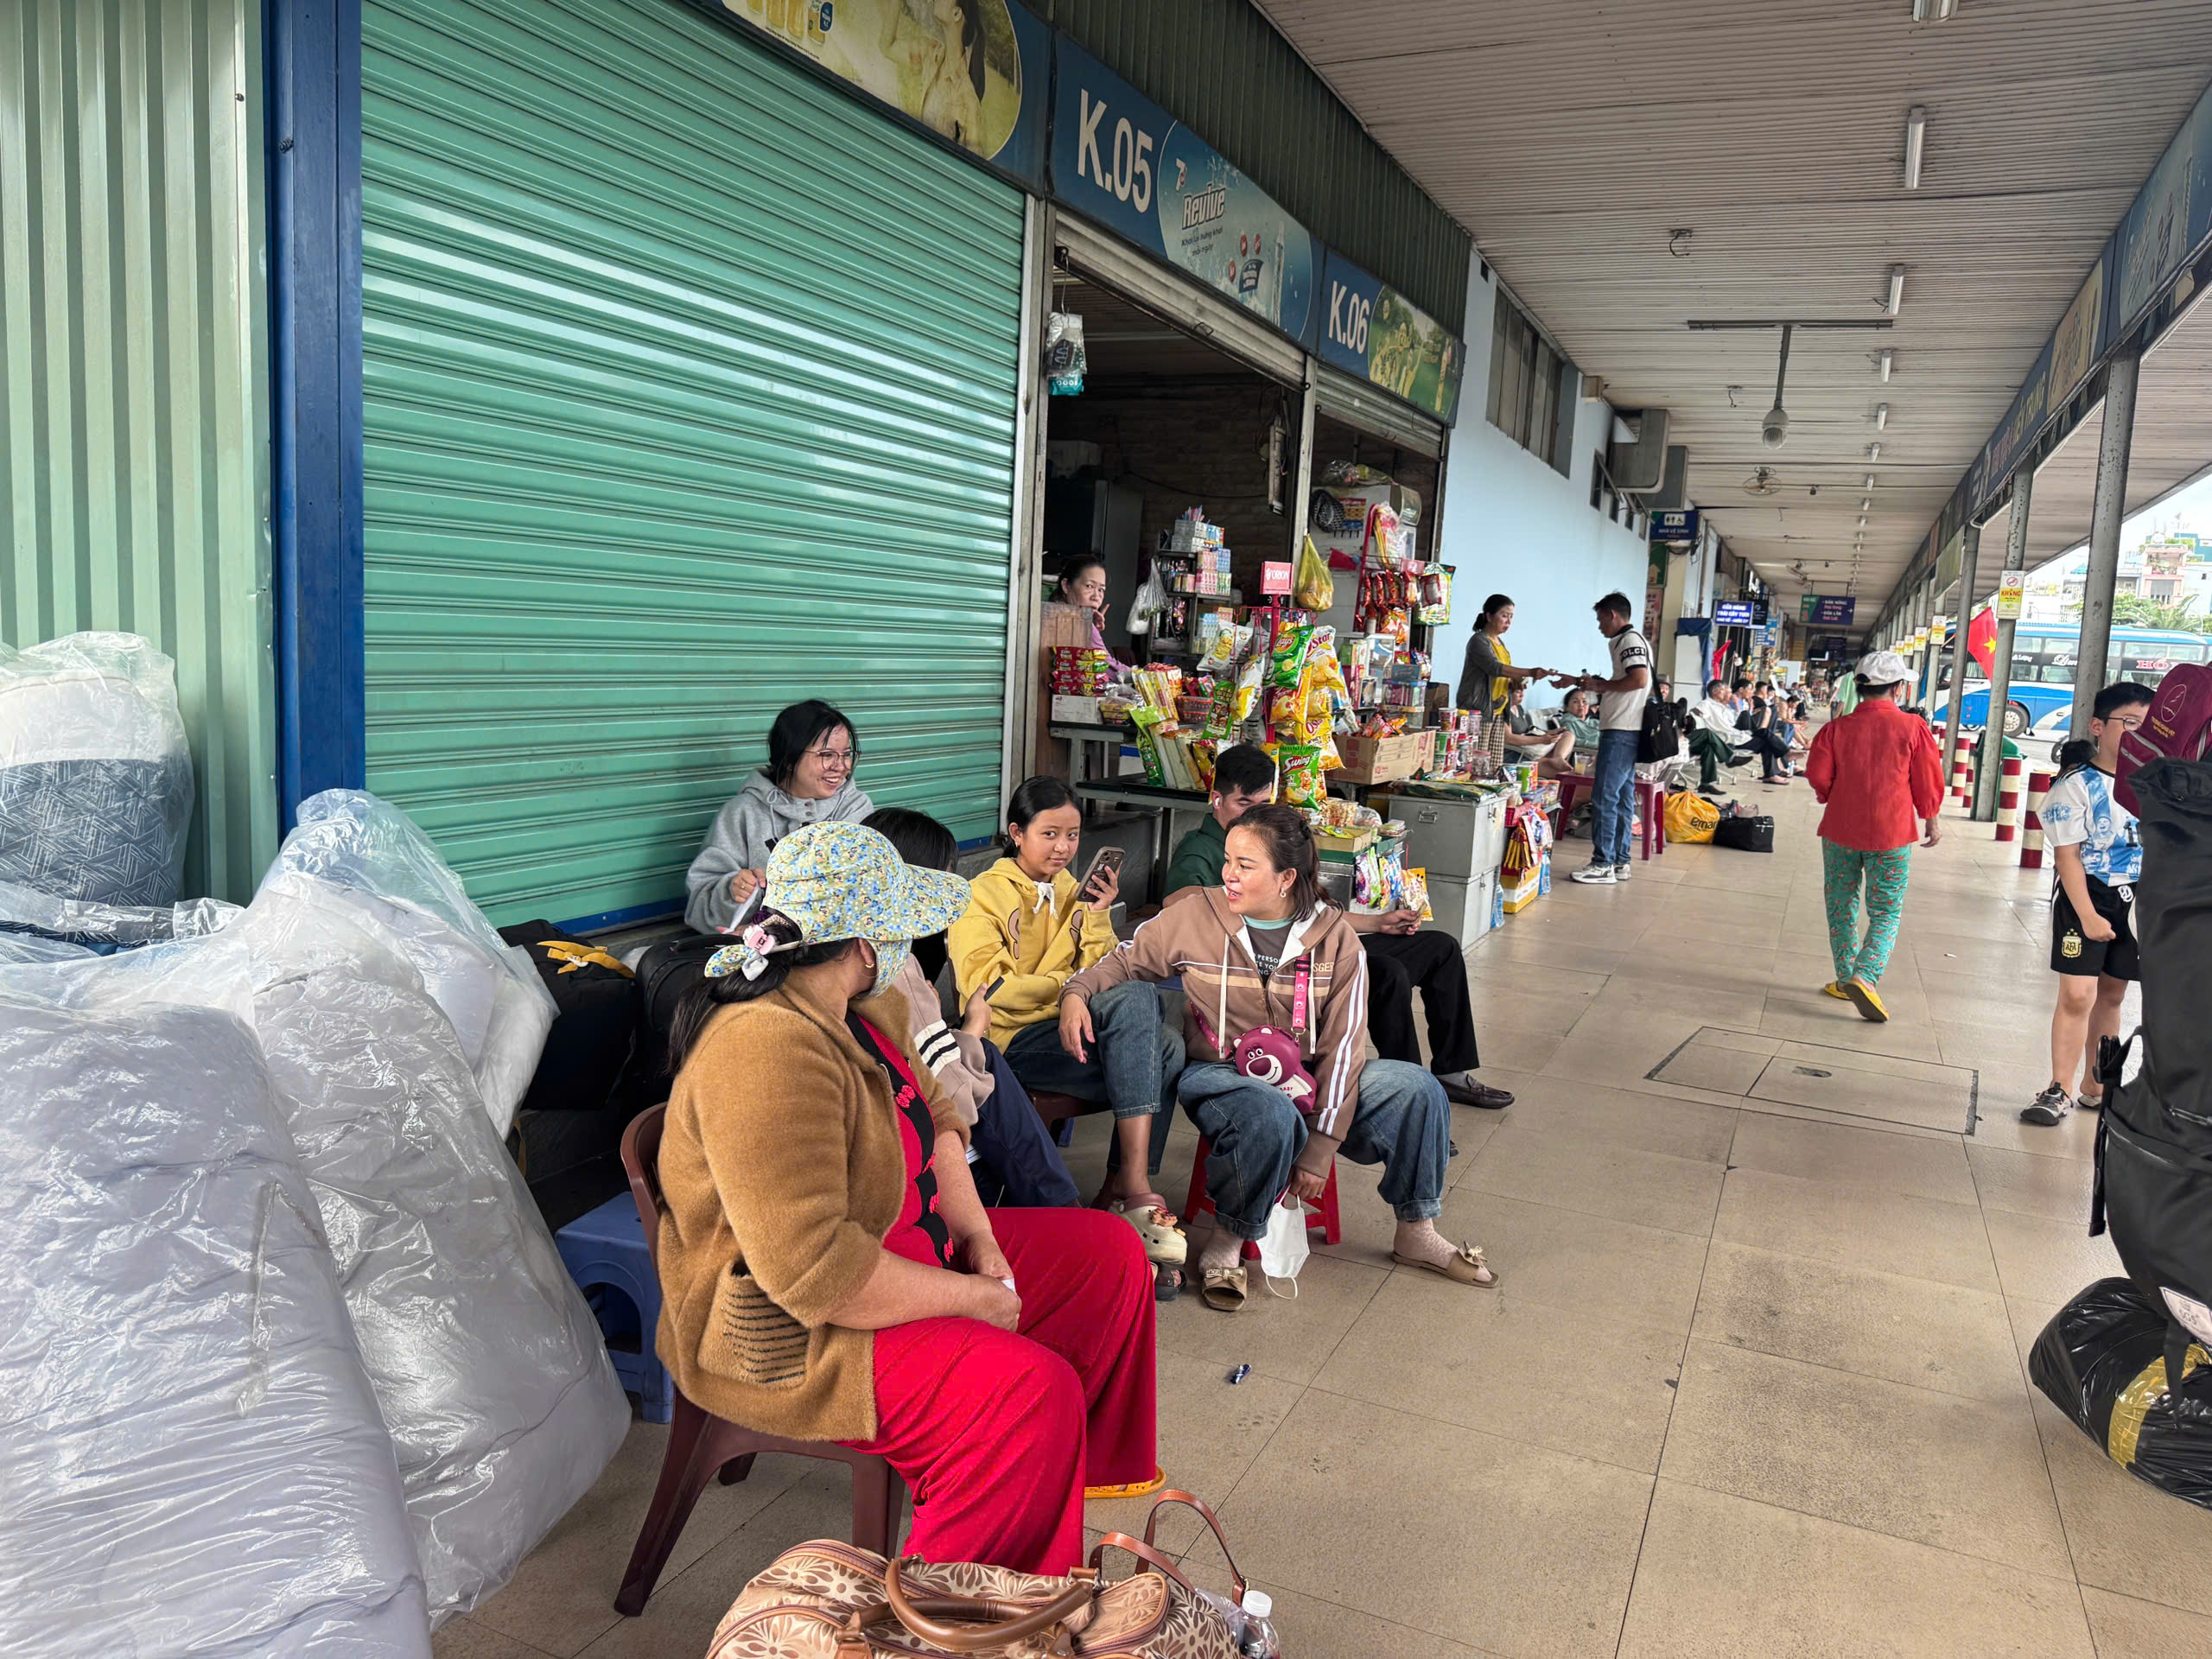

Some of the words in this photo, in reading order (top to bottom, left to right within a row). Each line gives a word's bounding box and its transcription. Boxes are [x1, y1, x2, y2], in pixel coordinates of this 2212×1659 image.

[1077, 88, 1153, 213] K.05
[1182, 182, 1225, 230] Revive
[1328, 281, 1370, 353] K.06
[1282, 755, 1311, 774] Swing
